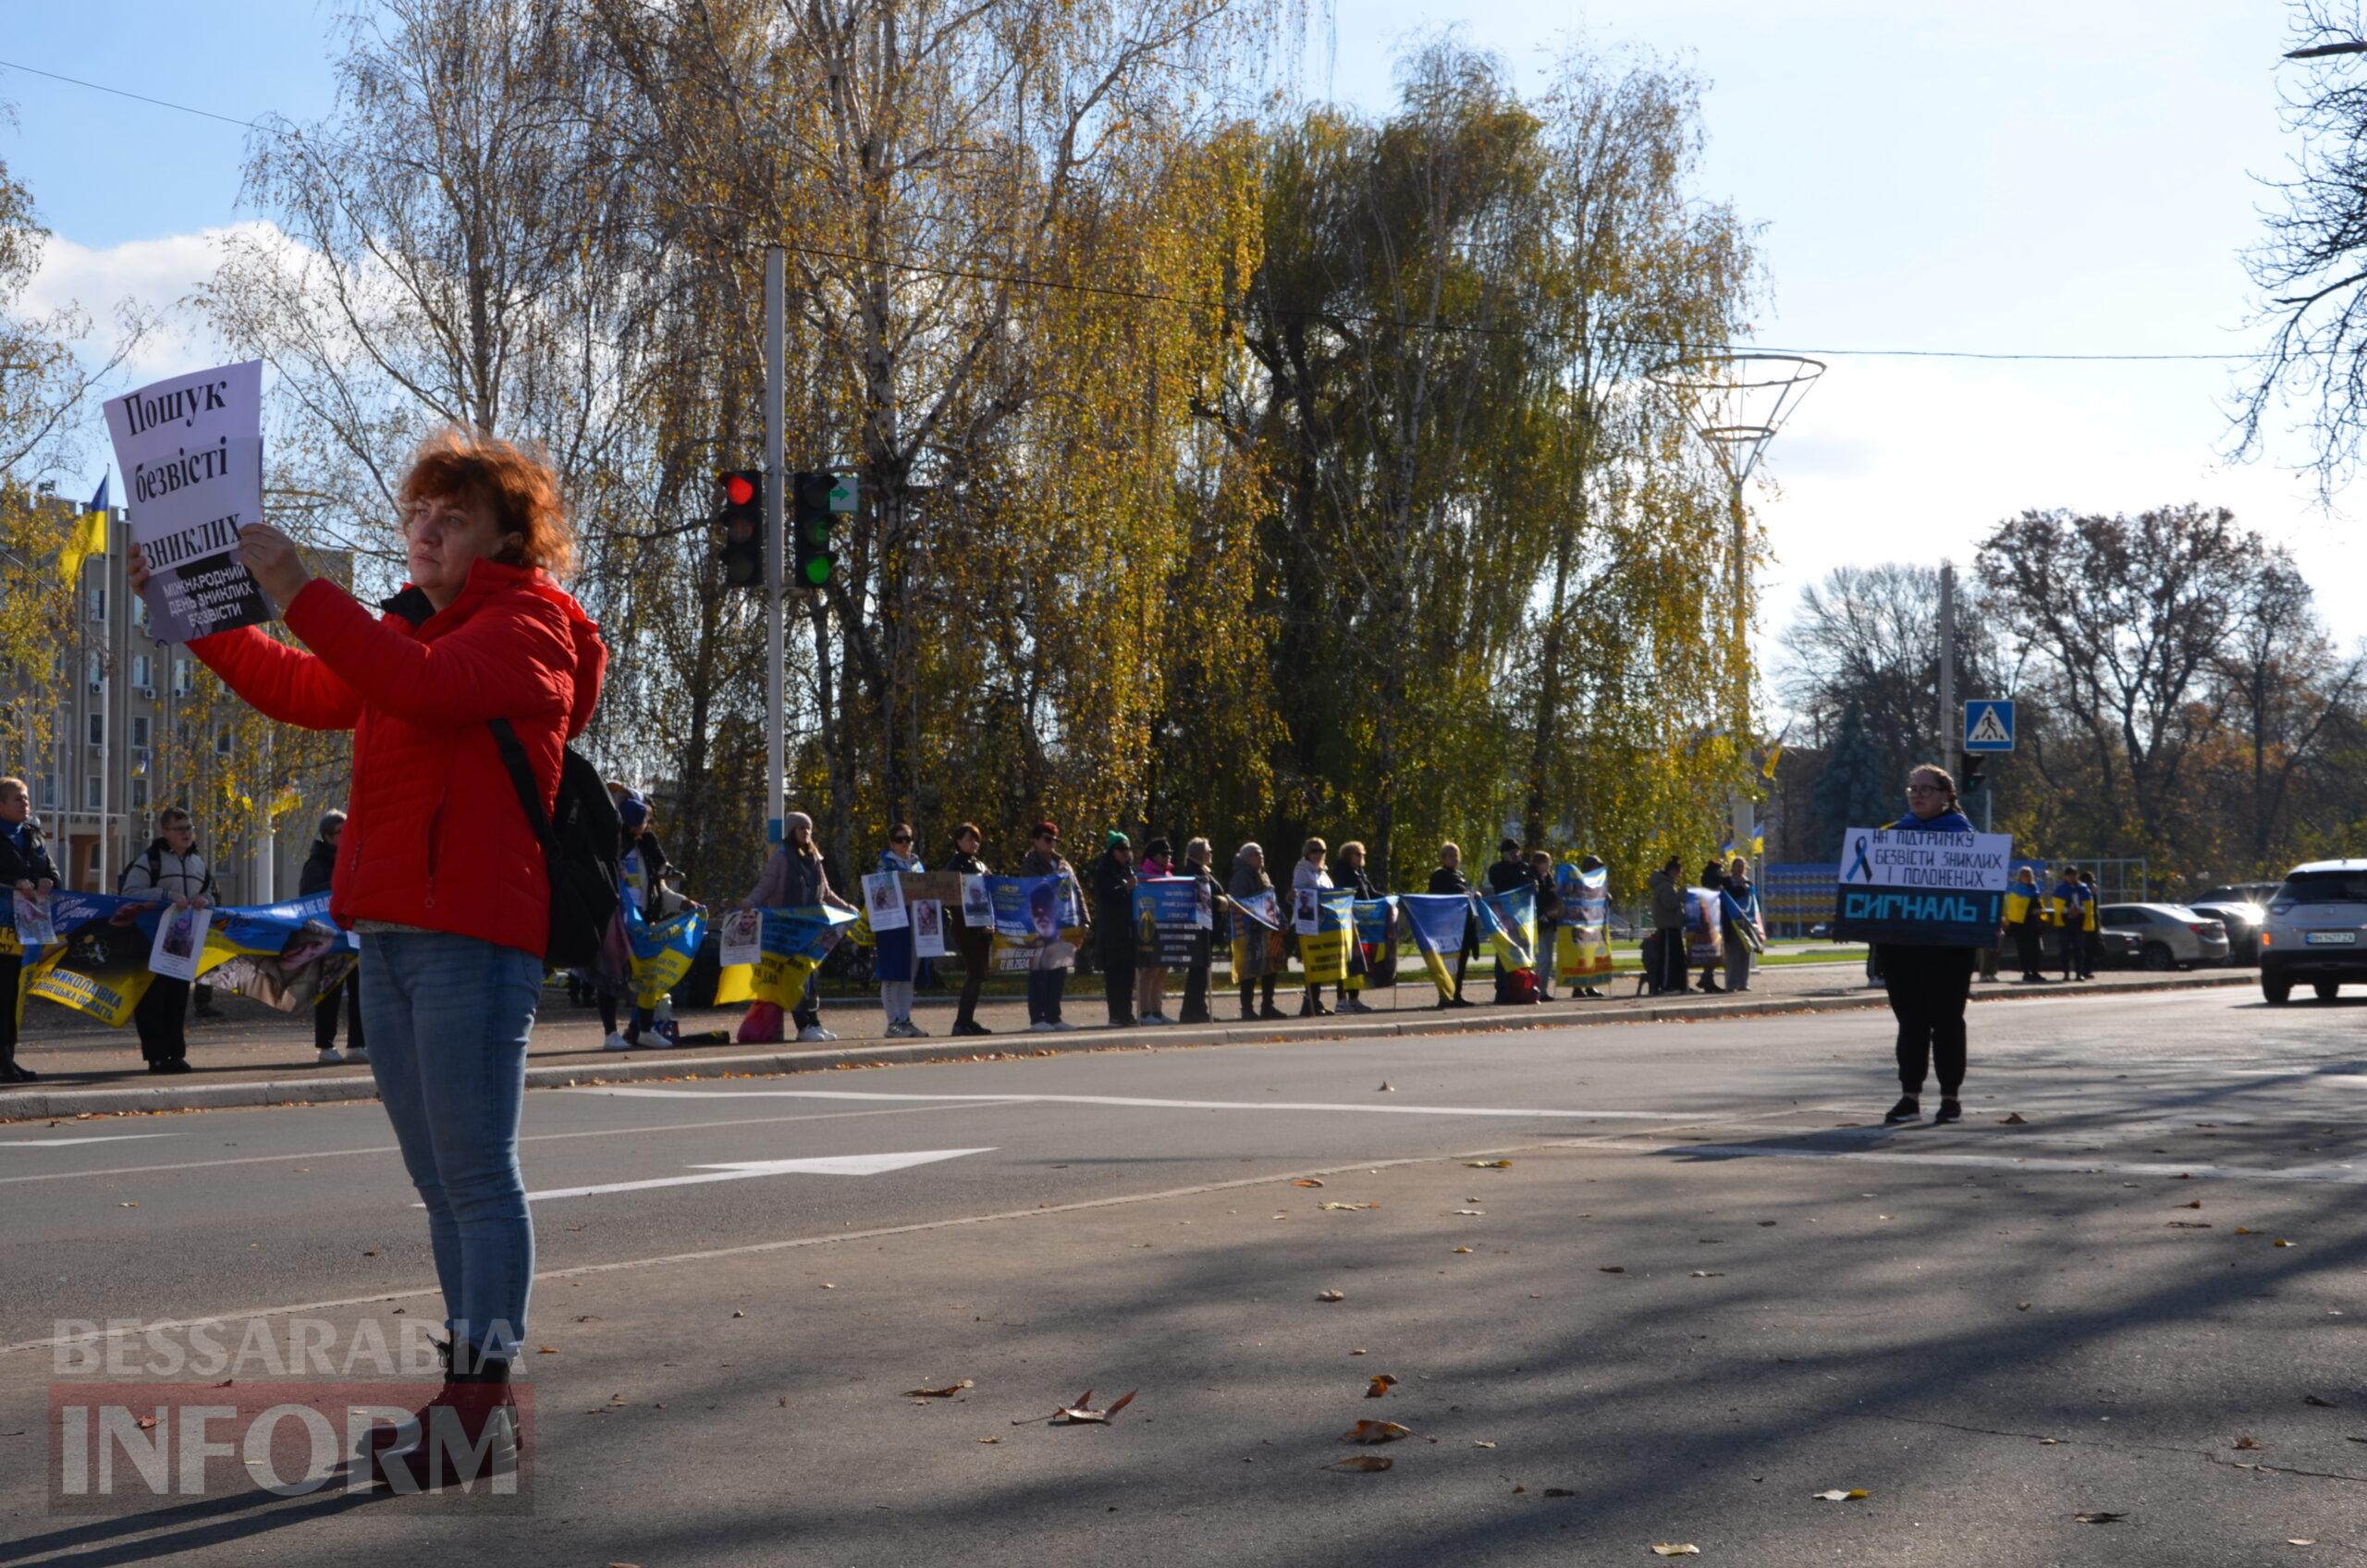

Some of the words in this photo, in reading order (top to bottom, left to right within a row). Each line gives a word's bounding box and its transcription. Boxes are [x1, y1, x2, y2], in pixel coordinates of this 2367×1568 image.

[123, 381, 227, 436] Пошук
[135, 435, 228, 503] безвісті
[141, 513, 243, 570] зниклих
[163, 562, 247, 598] МІЖНАРОДНИЙ
[168, 595, 197, 618] ДЕНЬ
[197, 582, 254, 607] ЗНИКЛИХ
[188, 602, 242, 628] БЕЗВІСТИ
[1872, 829, 1888, 844] НА
[1896, 830, 1975, 848] ПІДТРИМКУ
[1875, 848, 1934, 866] БЕЗВІСТИ
[1941, 851, 2003, 870] ЗНИКЛИХ
[1903, 867, 1984, 888] ПОЛОНЕНИХ
